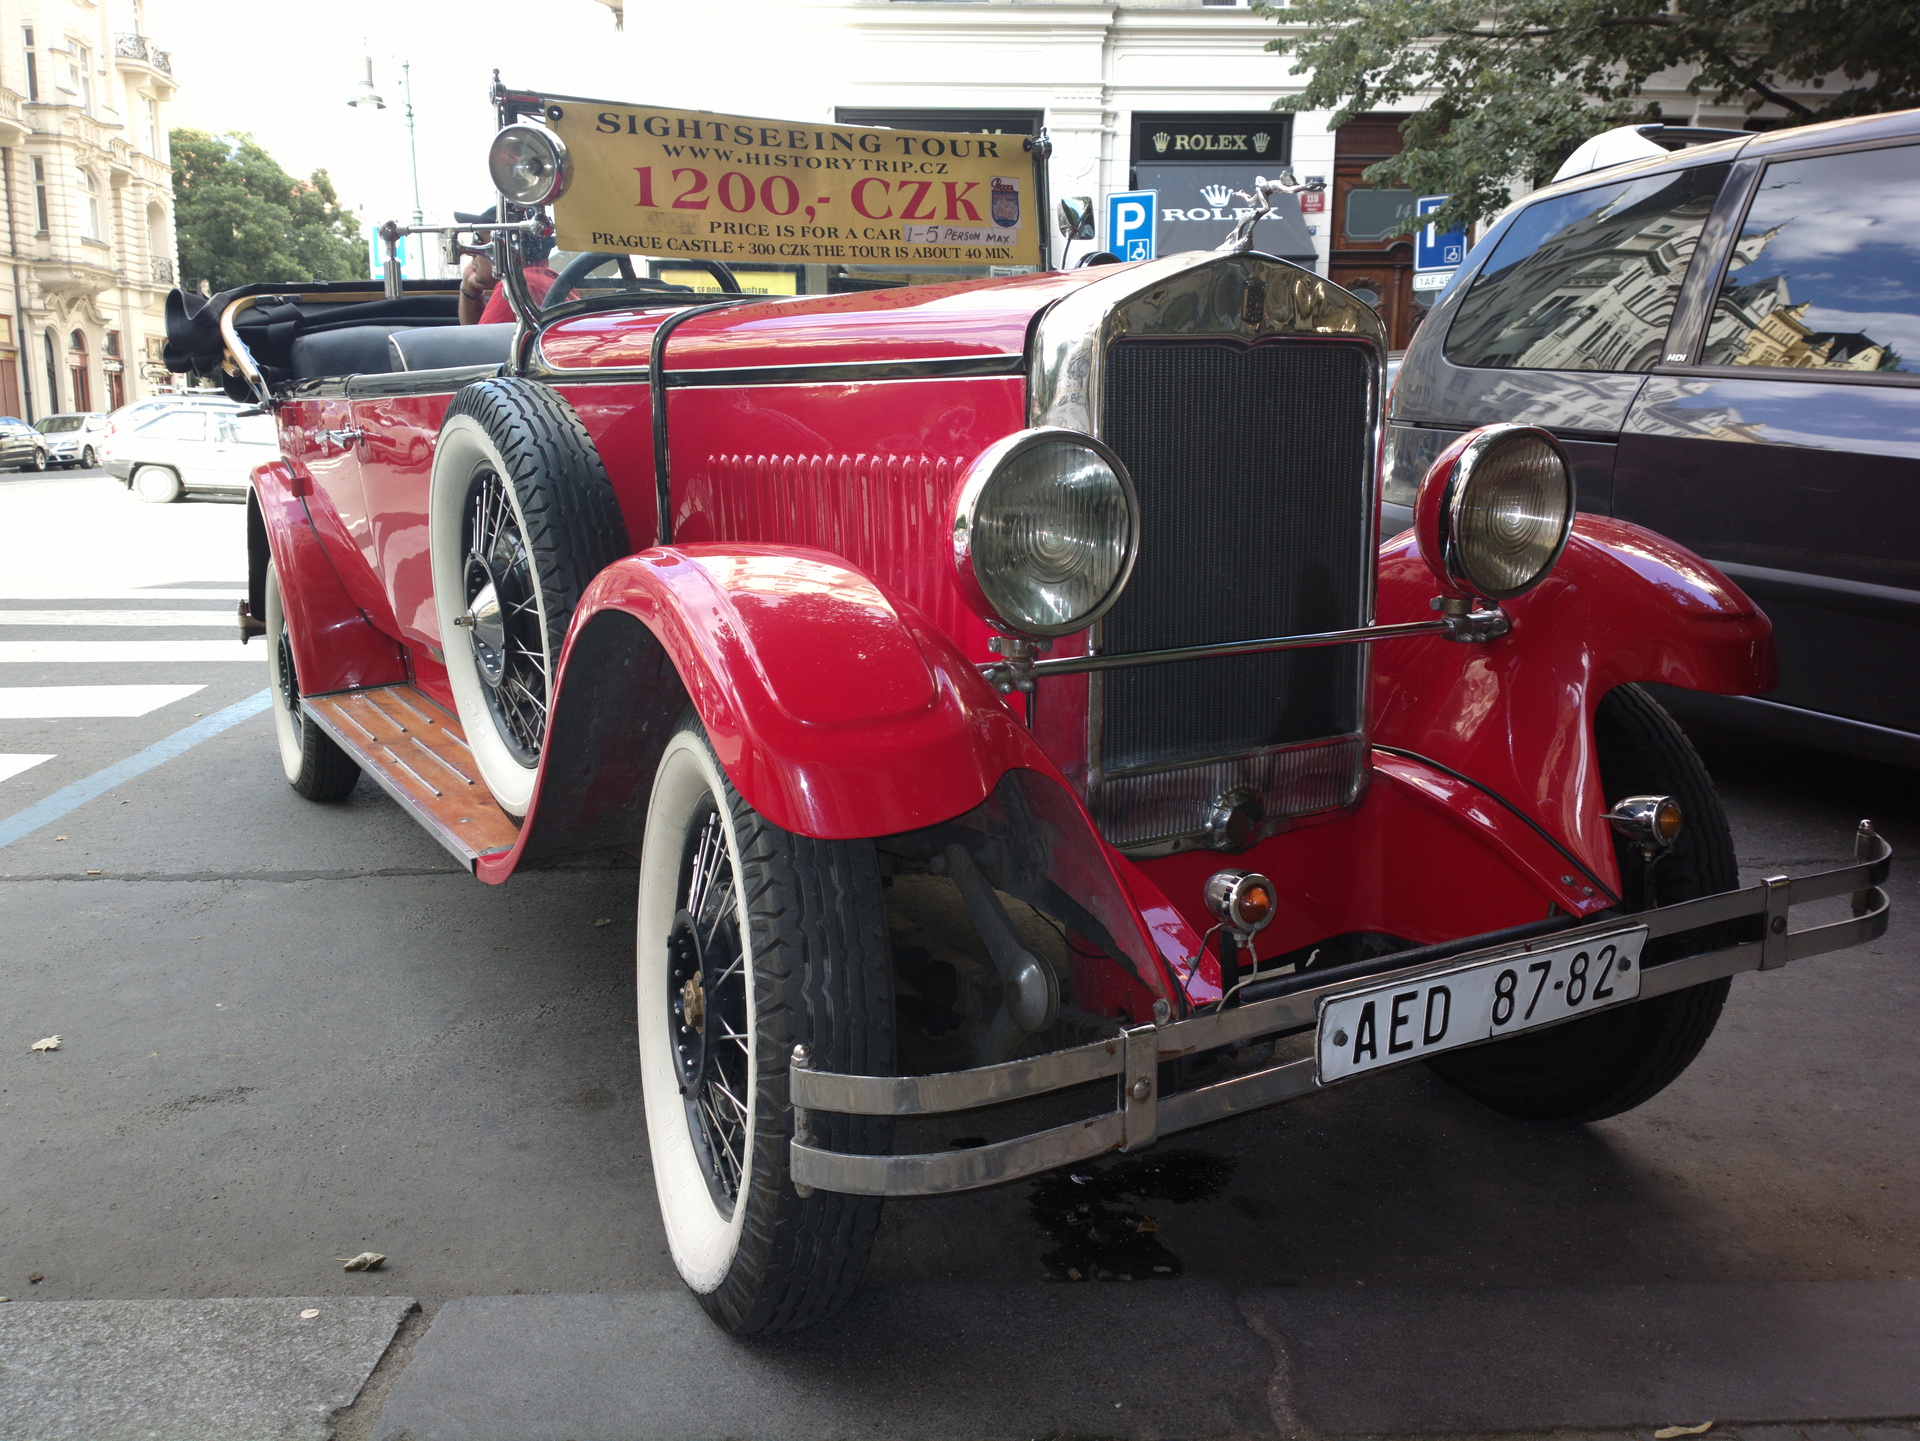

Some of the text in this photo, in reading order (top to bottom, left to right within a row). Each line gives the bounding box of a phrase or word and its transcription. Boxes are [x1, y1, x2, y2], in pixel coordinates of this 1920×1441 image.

[595, 112, 1000, 158] SIGHTSEEING TOUR
[1174, 134, 1248, 151] ROLEX
[661, 143, 949, 174] WWW.HISTORYTRIP.CZ
[633, 165, 983, 224] 1200,- CZK
[1116, 202, 1146, 247] P
[1395, 204, 1411, 218] 14
[709, 221, 902, 240] PRICE IS FOR A CAR
[906, 224, 940, 244] 1-5
[944, 228, 981, 241] PERSON
[592, 231, 1014, 260] PRAGUE CASTLE + 300 CZK THE TOUR IS ABOUT 40 MIN.
[1666, 353, 1687, 362] HDI
[1352, 945, 1617, 1064] AED 87-82
